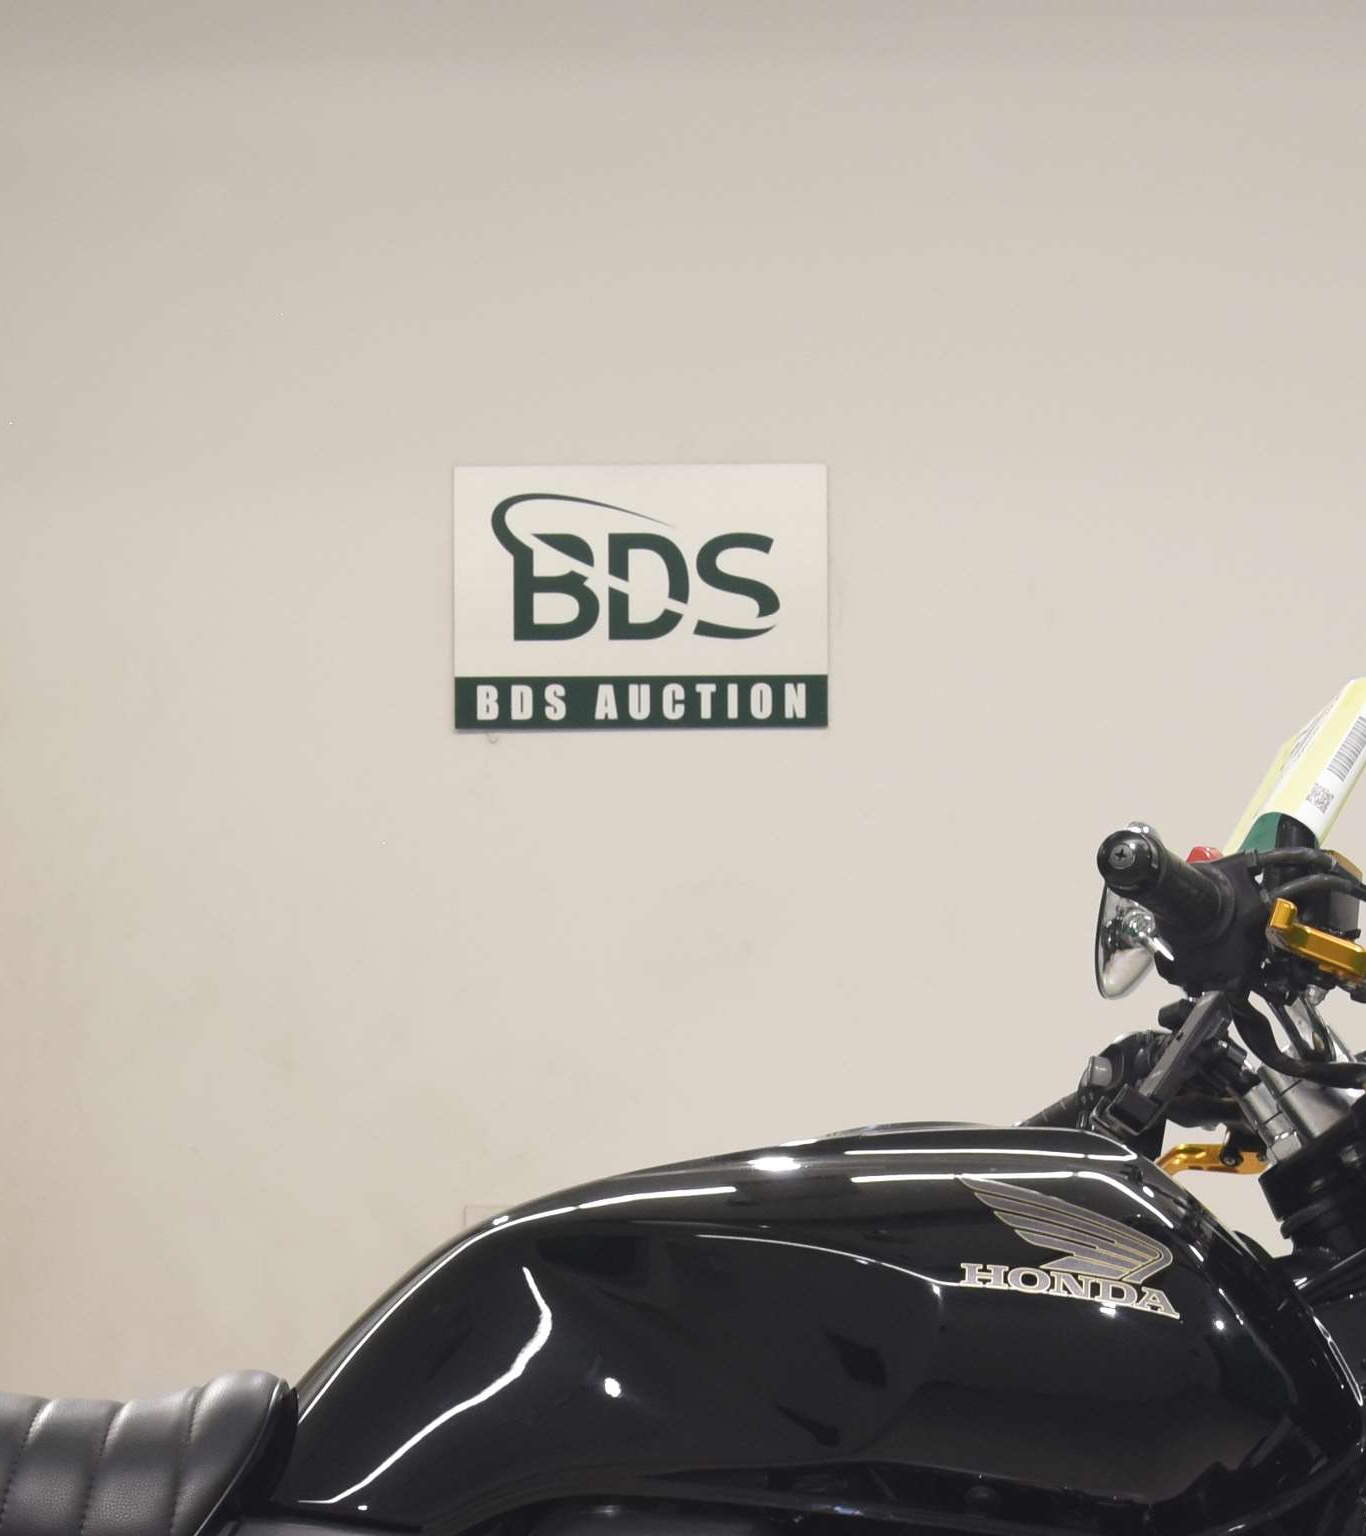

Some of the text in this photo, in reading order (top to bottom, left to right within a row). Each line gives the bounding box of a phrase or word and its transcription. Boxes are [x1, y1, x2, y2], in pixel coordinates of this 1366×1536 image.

[491, 493, 781, 641] BDS
[476, 682, 807, 721] BDS AUCTION
[960, 1263, 1181, 1320] HONDA
